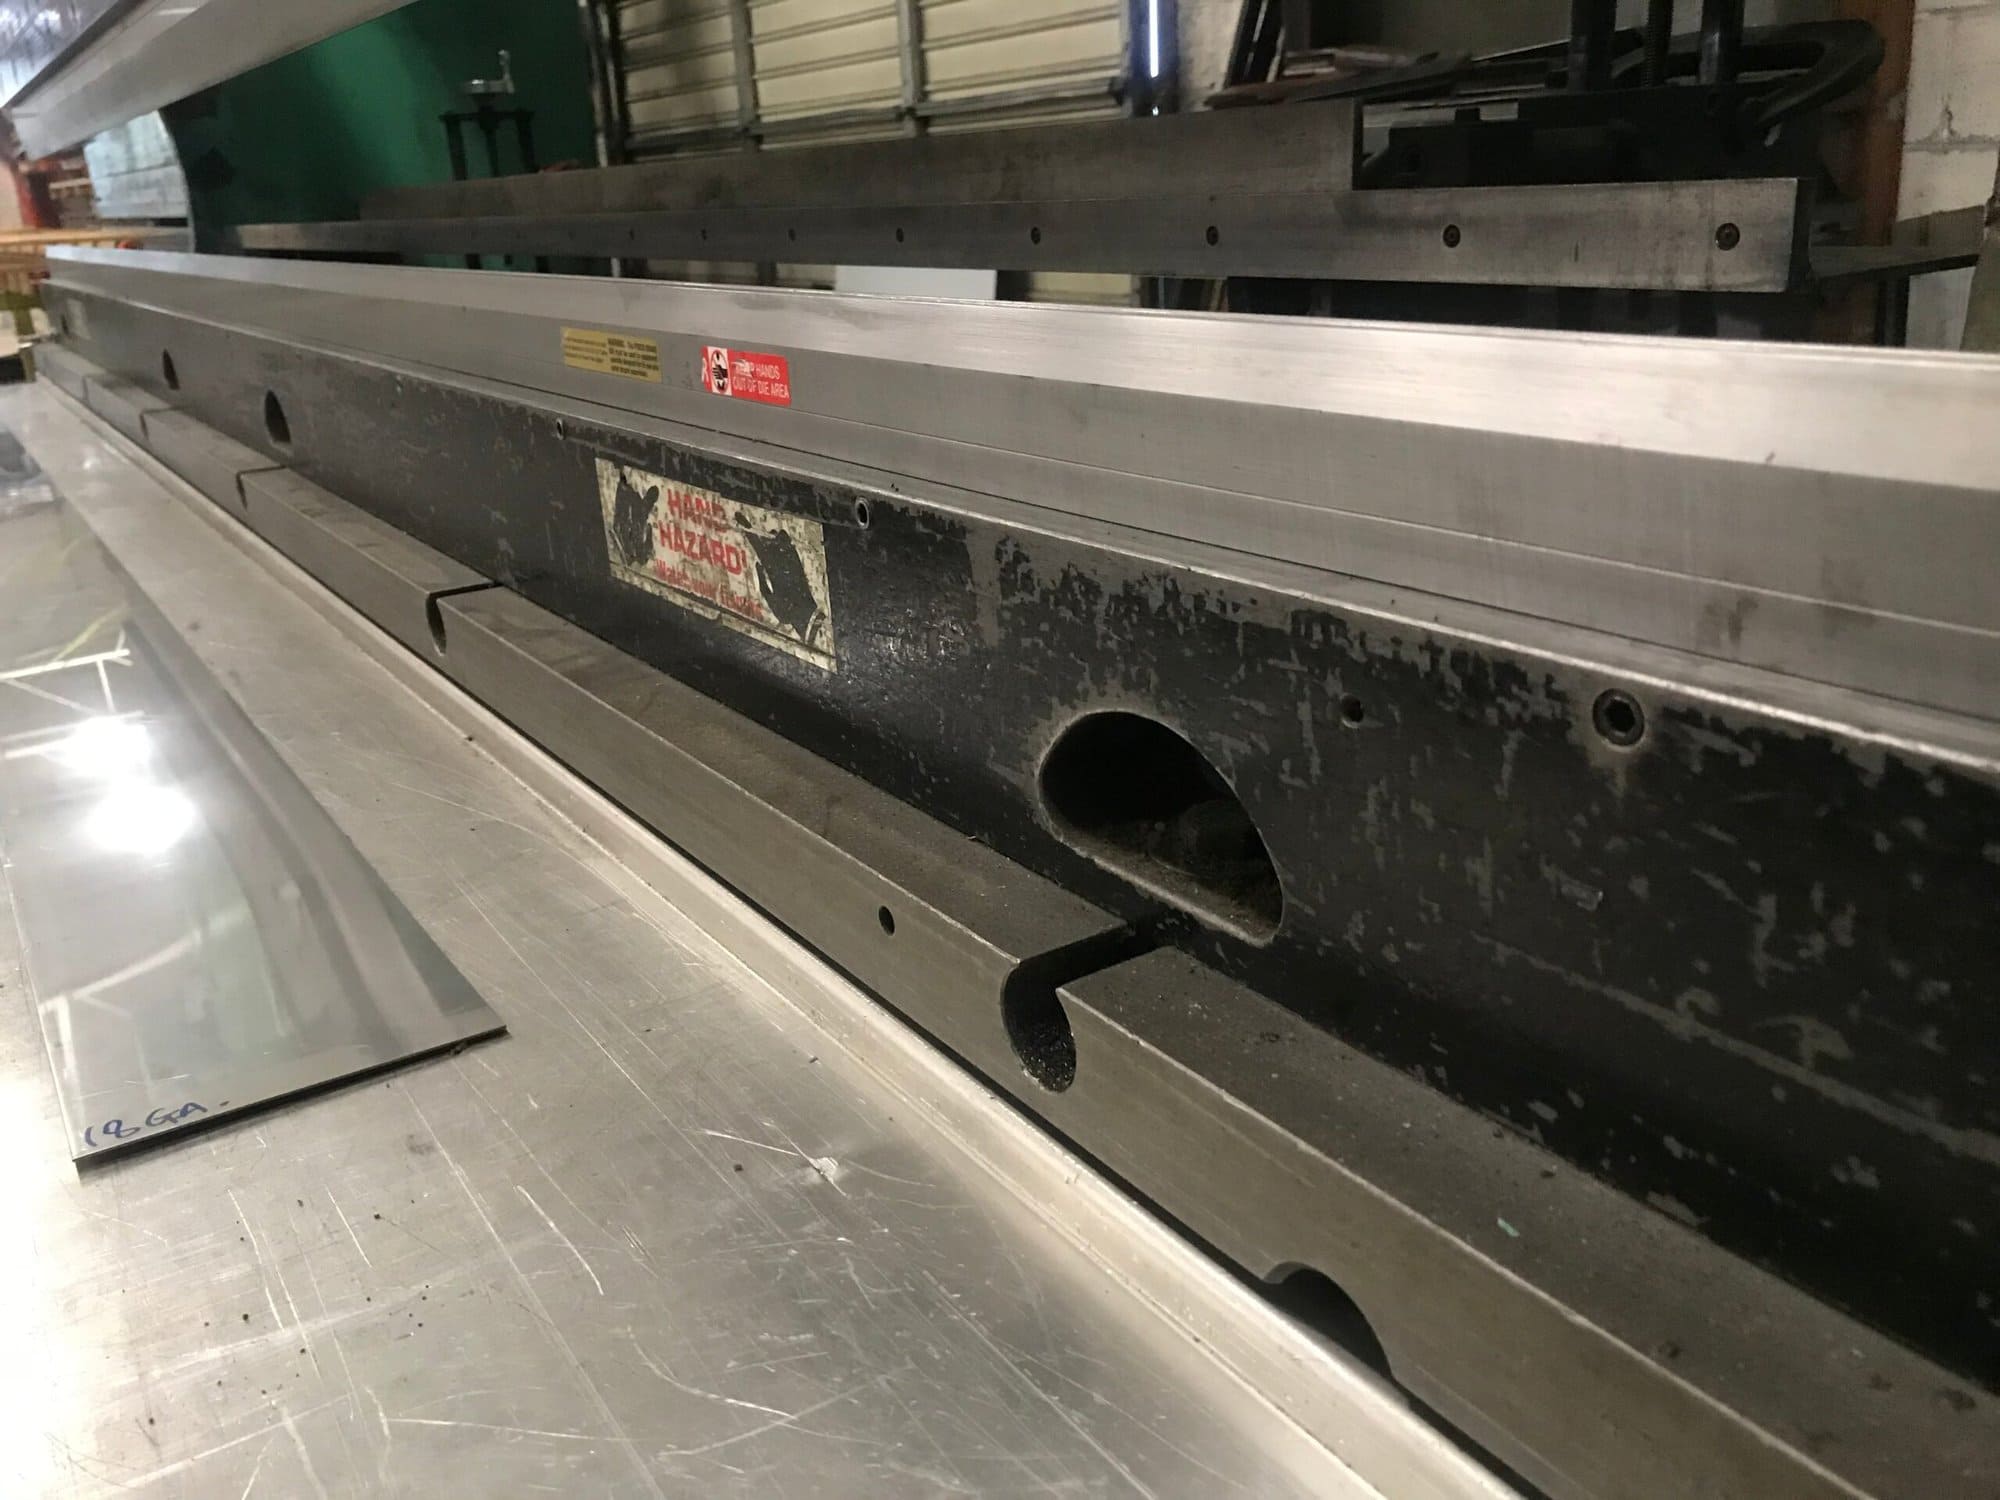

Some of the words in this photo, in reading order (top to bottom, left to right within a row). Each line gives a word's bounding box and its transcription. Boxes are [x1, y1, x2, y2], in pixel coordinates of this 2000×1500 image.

[756, 363, 781, 381] HANDS
[732, 376, 746, 392] OUT
[757, 380, 770, 396] DIE
[771, 382, 790, 399] AREA
[667, 488, 728, 534] HAND
